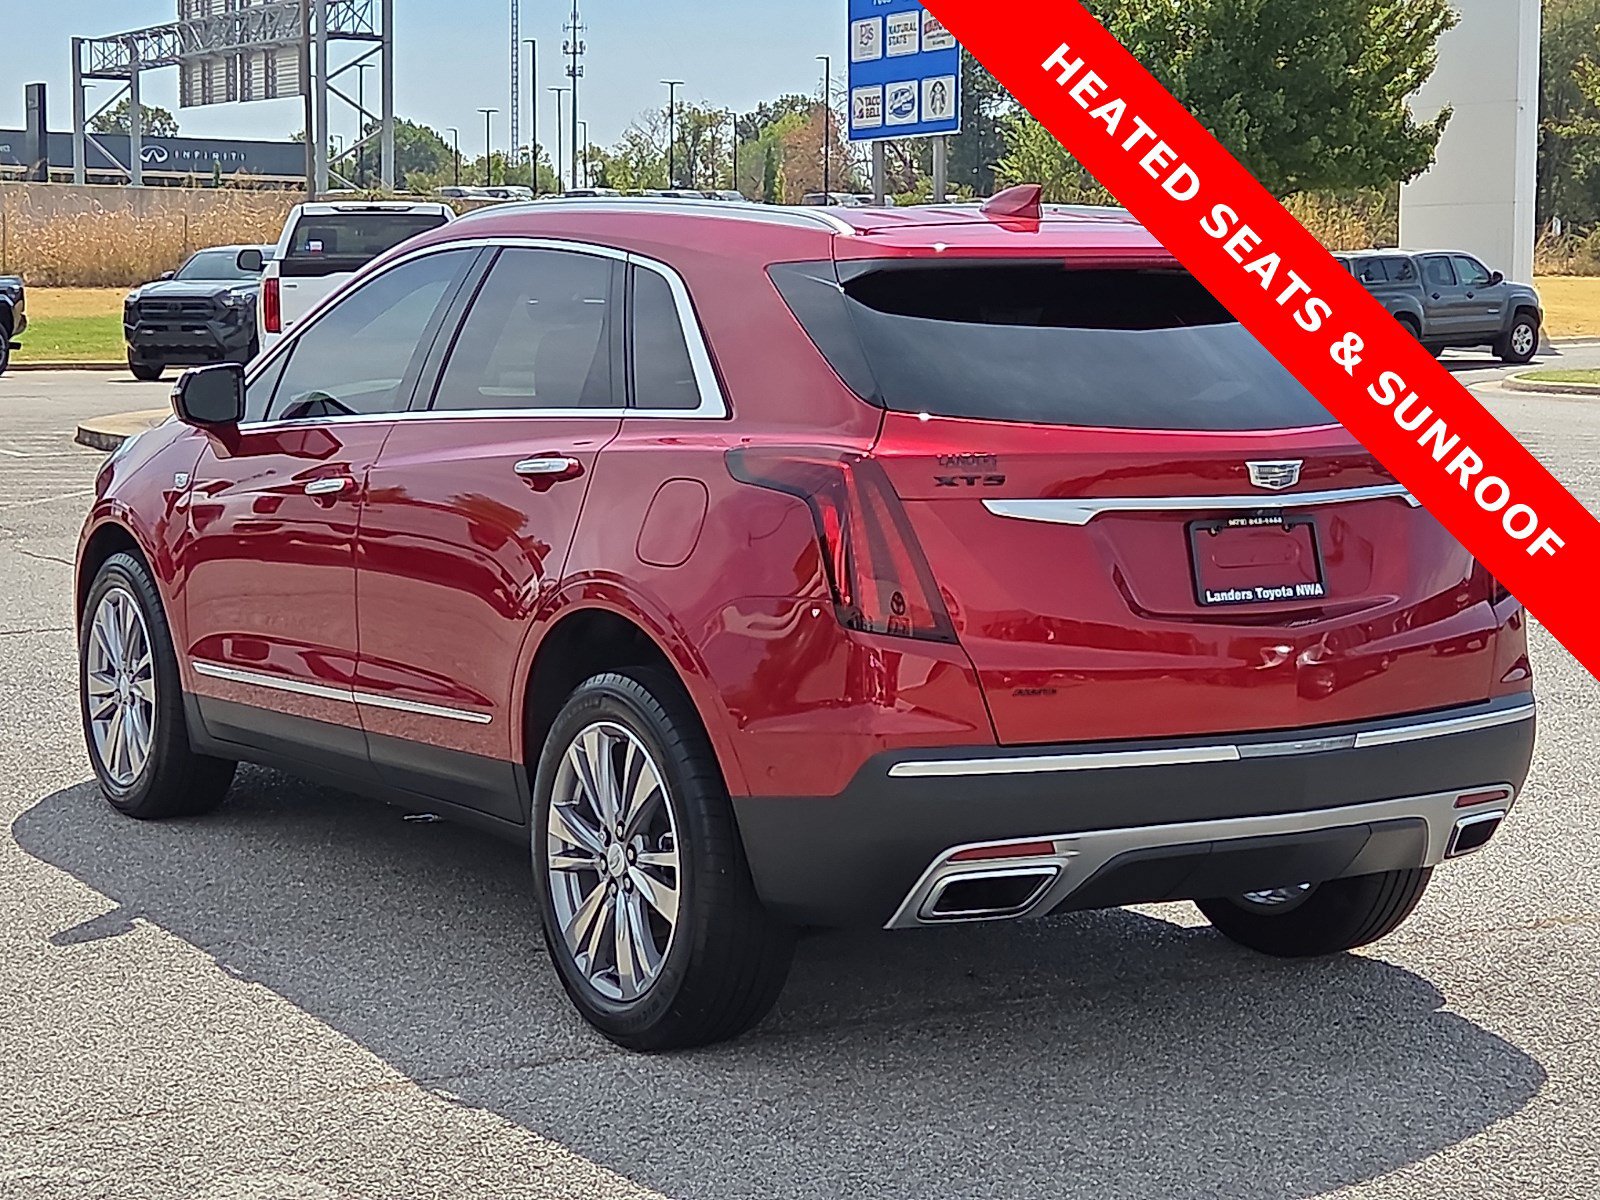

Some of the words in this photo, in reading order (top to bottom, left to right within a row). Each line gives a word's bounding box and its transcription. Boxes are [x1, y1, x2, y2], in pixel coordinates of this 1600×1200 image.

[865, 106, 880, 118] BELL
[1206, 589, 1253, 602] Landers
[1255, 586, 1294, 600] Toyota
[1296, 583, 1323, 597] NWA
